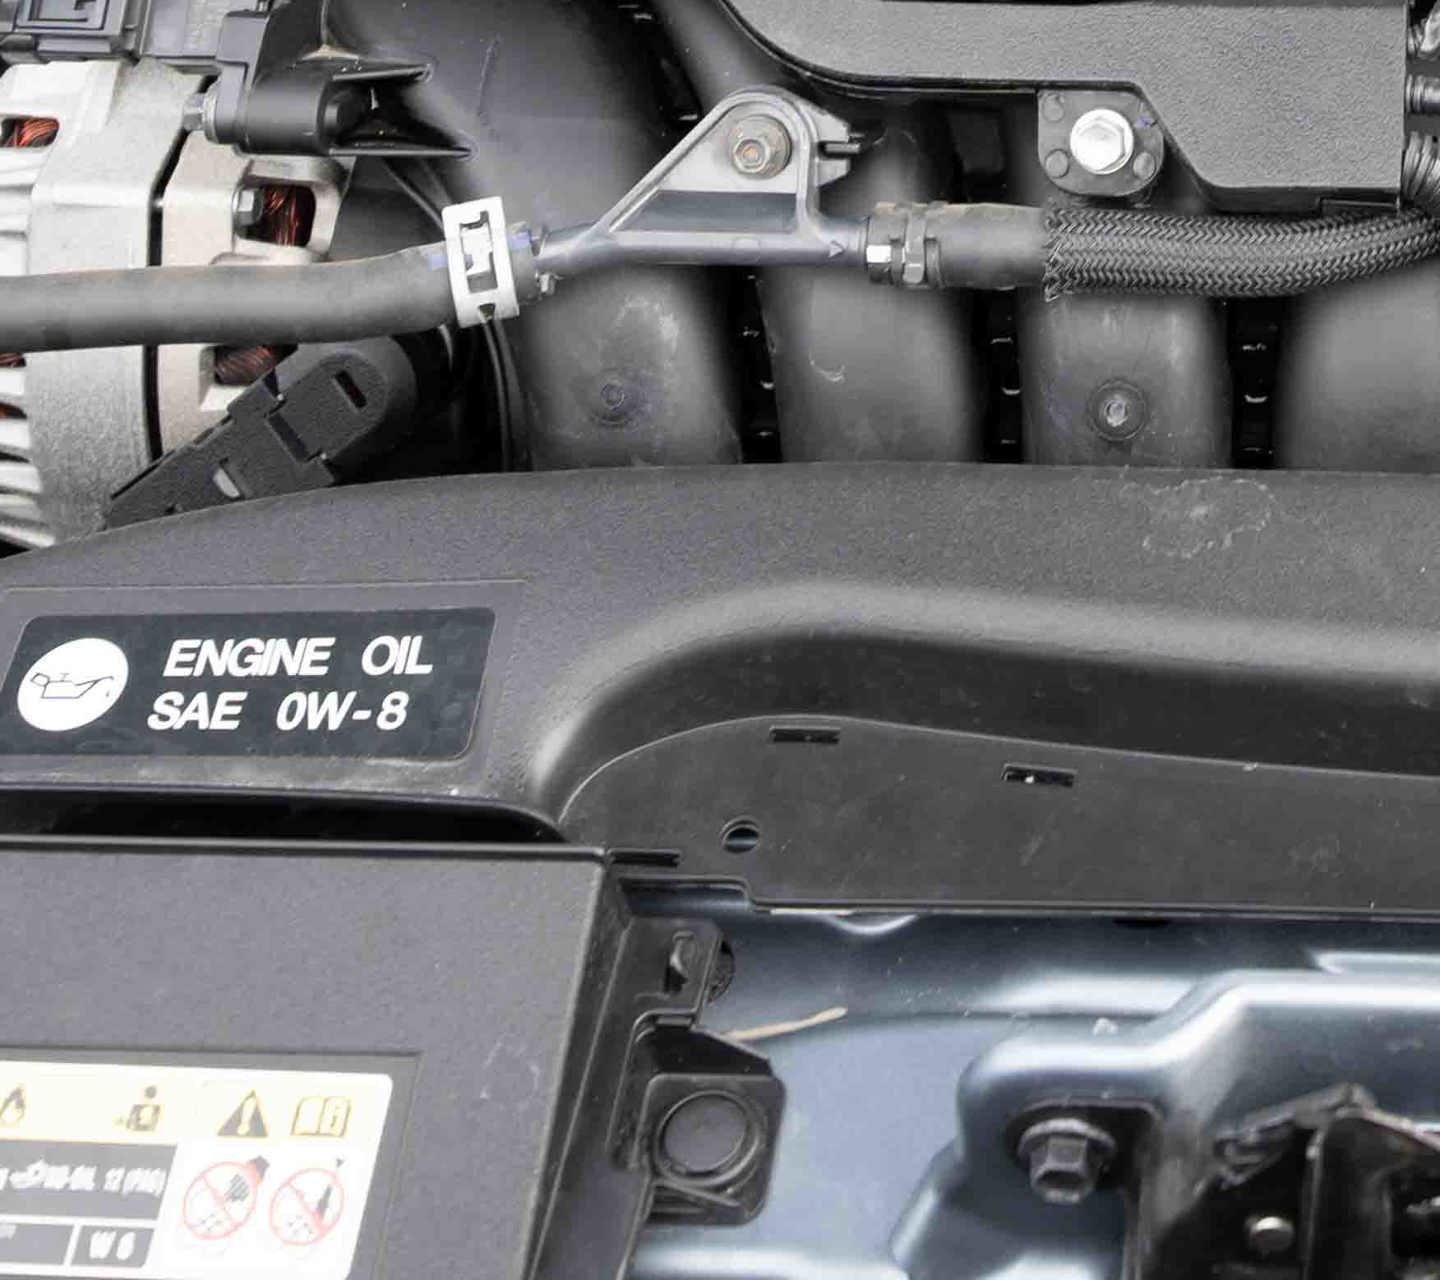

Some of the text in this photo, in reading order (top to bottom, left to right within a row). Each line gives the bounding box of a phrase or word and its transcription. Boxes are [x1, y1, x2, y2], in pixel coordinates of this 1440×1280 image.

[162, 633, 435, 678] ENGINE OIL
[146, 690, 411, 732] SAE 0W-8
